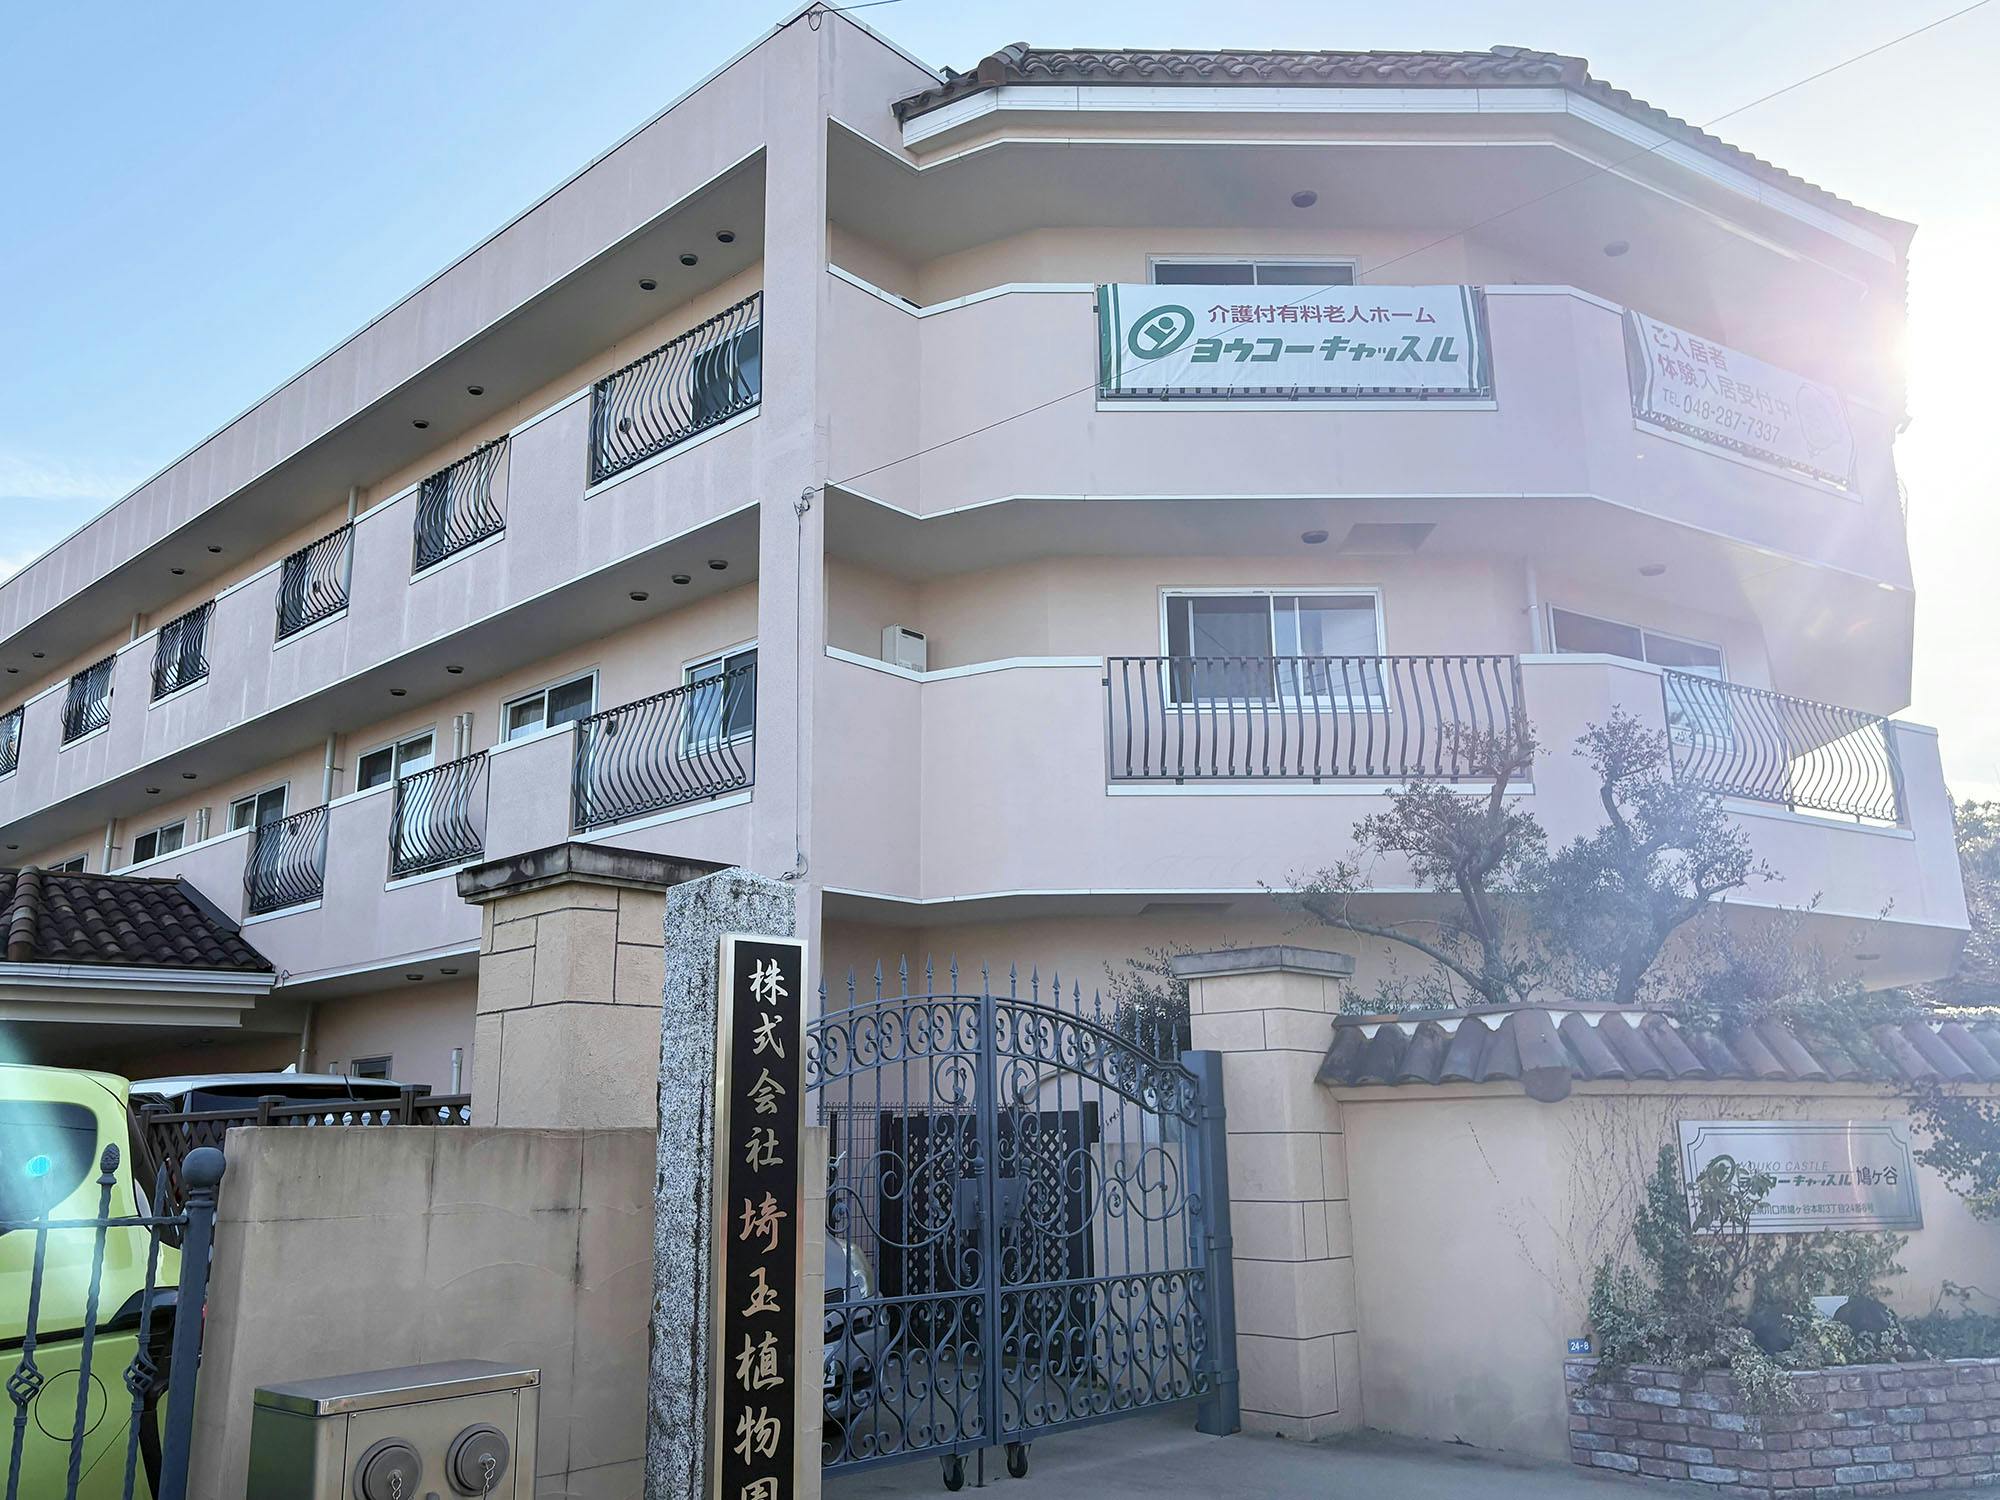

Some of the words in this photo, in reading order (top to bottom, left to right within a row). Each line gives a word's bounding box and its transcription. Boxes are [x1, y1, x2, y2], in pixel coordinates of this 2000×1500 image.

[1207, 304, 1436, 324] 介護付有料老人ホーム
[1190, 335, 1459, 363] ヨウコーキャッスル
[1651, 325, 1728, 372] ご入居者
[1657, 353, 1792, 420] 体験入居受付中
[1683, 394, 1780, 444] 048-287-7337
[1785, 1160, 1829, 1172] CASTLE
